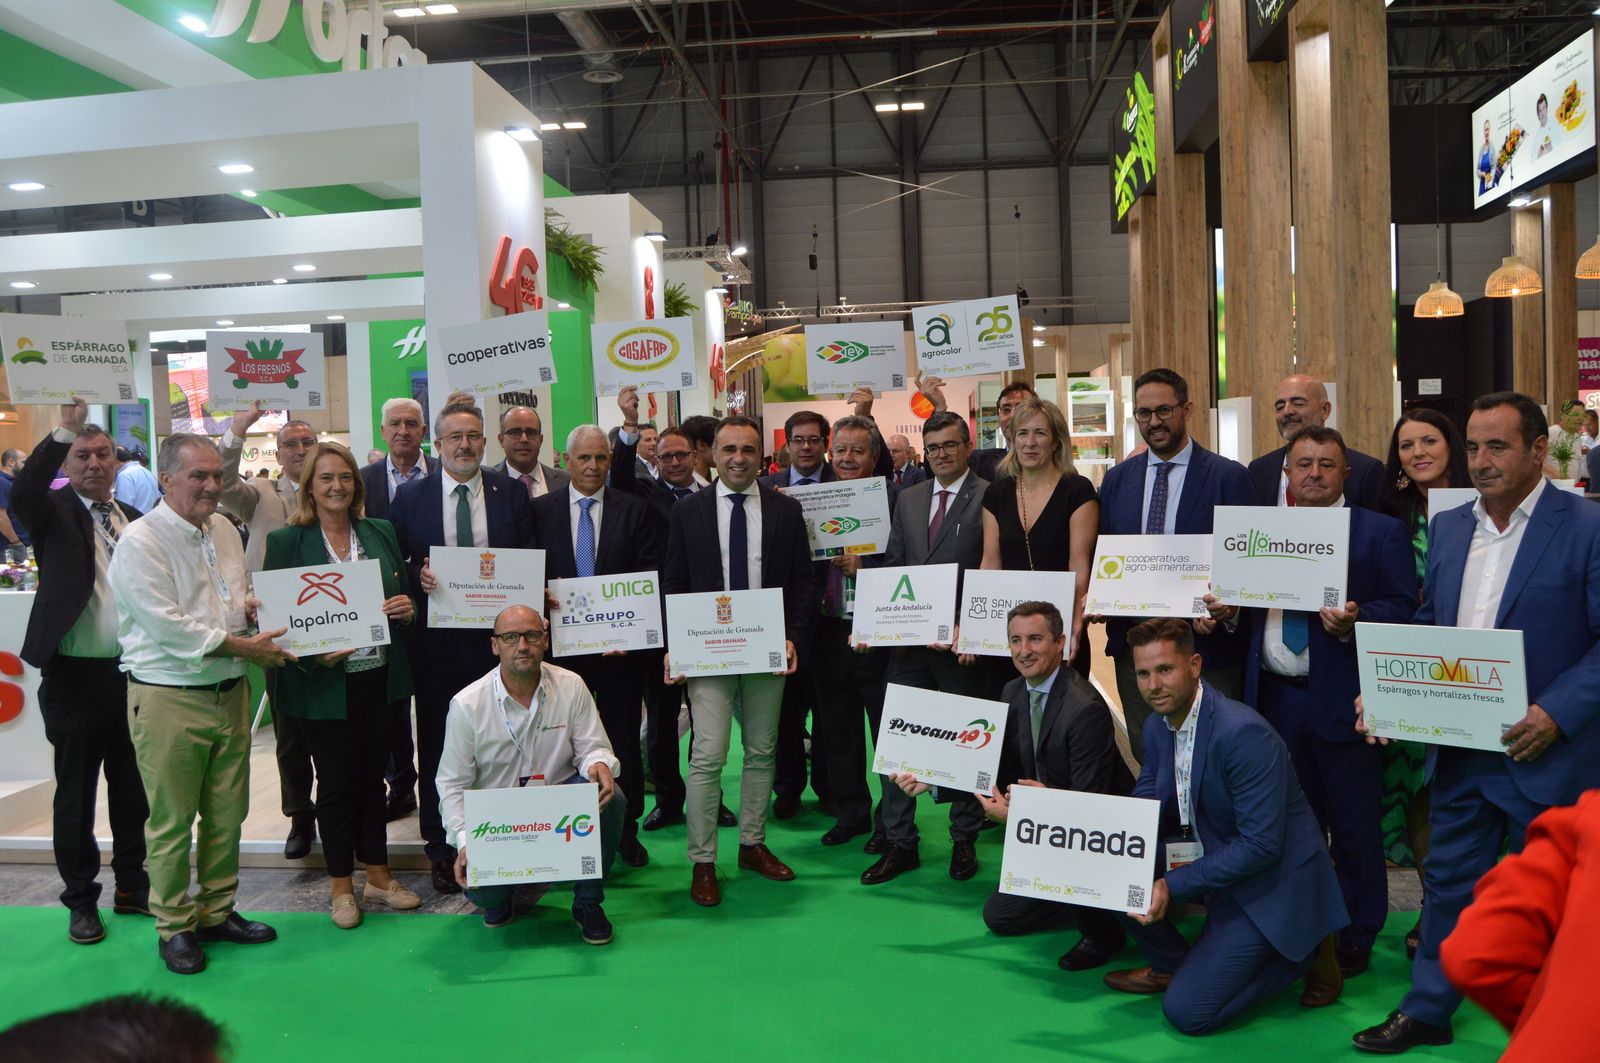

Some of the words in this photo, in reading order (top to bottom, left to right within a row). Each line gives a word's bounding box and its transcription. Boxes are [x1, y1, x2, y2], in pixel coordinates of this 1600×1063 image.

[51, 340, 125, 353] ESPÁRRAGO
[447, 337, 546, 365] Cooperativas
[618, 339, 668, 361] COSAFRA
[53, 354, 68, 363] DE
[71, 354, 127, 364] GRANADA
[922, 347, 962, 360] agrocolor
[111, 365, 128, 373] SCA
[241, 362, 256, 374] LOS
[257, 362, 291, 375] FRESNOS
[1224, 528, 1334, 556] Gallombares
[1126, 555, 1190, 565] cooperativas
[1125, 563, 1210, 574] agro-alimentarias
[449, 581, 486, 590] Diputación
[1240, 588, 1264, 600] faeca
[902, 602, 932, 611] Andalucía
[991, 599, 1012, 608] SAN
[1113, 600, 1137, 610] faeca
[562, 616, 580, 625] EL
[585, 611, 635, 622] GRUPO
[991, 610, 1004, 619] DE
[289, 611, 358, 632] lapalma
[687, 627, 725, 637] Diputación
[735, 625, 764, 634] Granada
[1375, 657, 1503, 686] HORTOVILLA
[1377, 684, 1421, 697] Espárragos
[1422, 690, 1428, 698] y
[1429, 688, 1471, 700] hortalizas
[1473, 693, 1505, 704] frescas
[889, 717, 958, 741] Procam
[1398, 719, 1428, 734] faeca
[471, 821, 552, 839] Hortoventas
[1016, 818, 1146, 859] Granada
[497, 866, 523, 878] faeca
[1033, 877, 1061, 893] faeca
